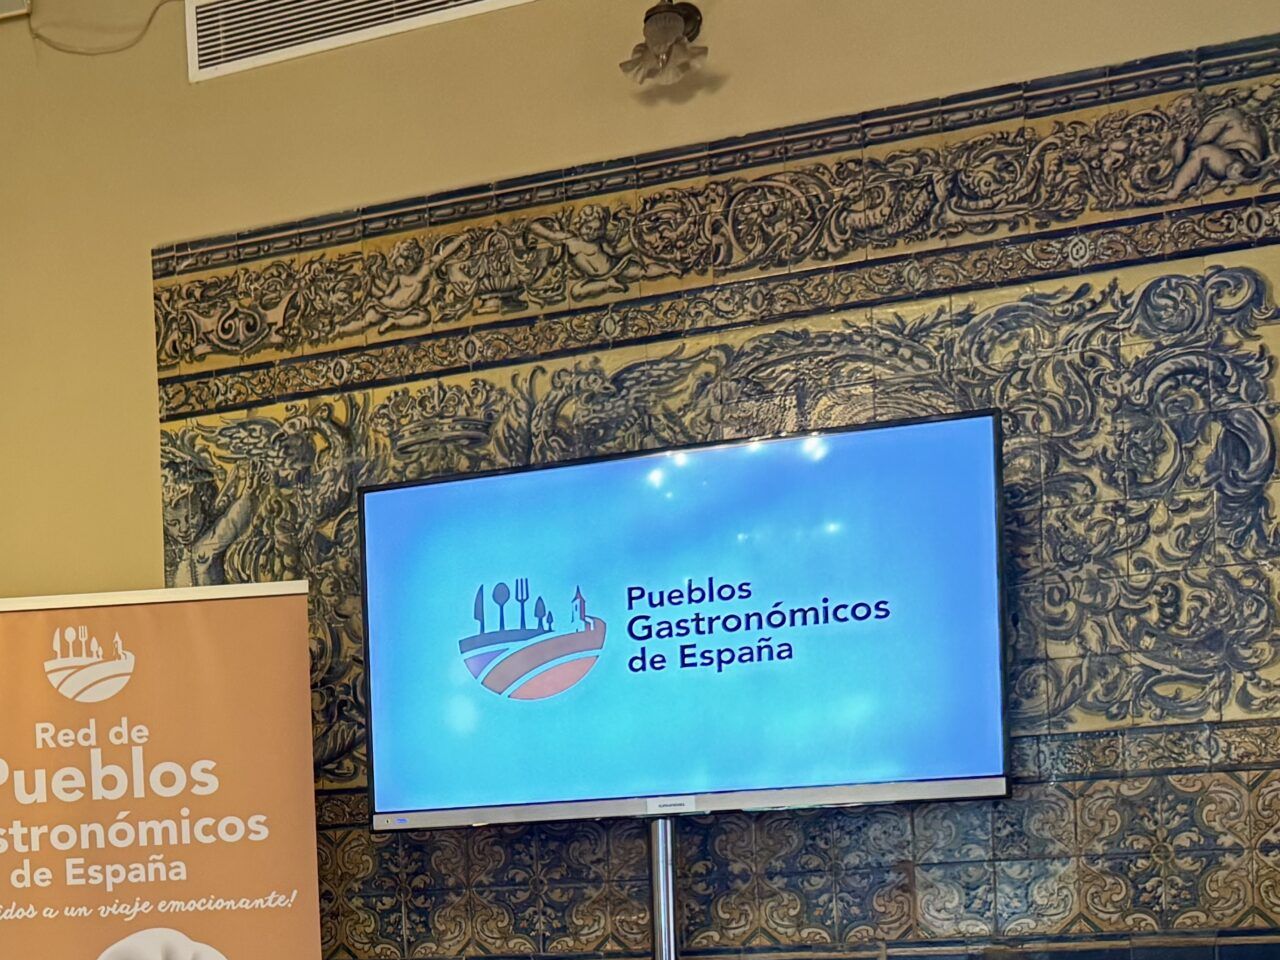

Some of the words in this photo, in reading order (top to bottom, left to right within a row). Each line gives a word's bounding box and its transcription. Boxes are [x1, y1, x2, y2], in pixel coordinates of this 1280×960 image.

[627, 576, 752, 611] Pueblos
[627, 597, 891, 641] Gastronómicos
[628, 646, 667, 673] de
[679, 636, 793, 674] España
[35, 718, 97, 749] Red
[108, 716, 150, 745] de
[10, 858, 53, 889] de
[65, 853, 187, 893] España
[42, 906, 60, 920] a
[63, 905, 95, 918] un
[97, 896, 154, 923] viaje
[157, 889, 298, 914] emocionante!
